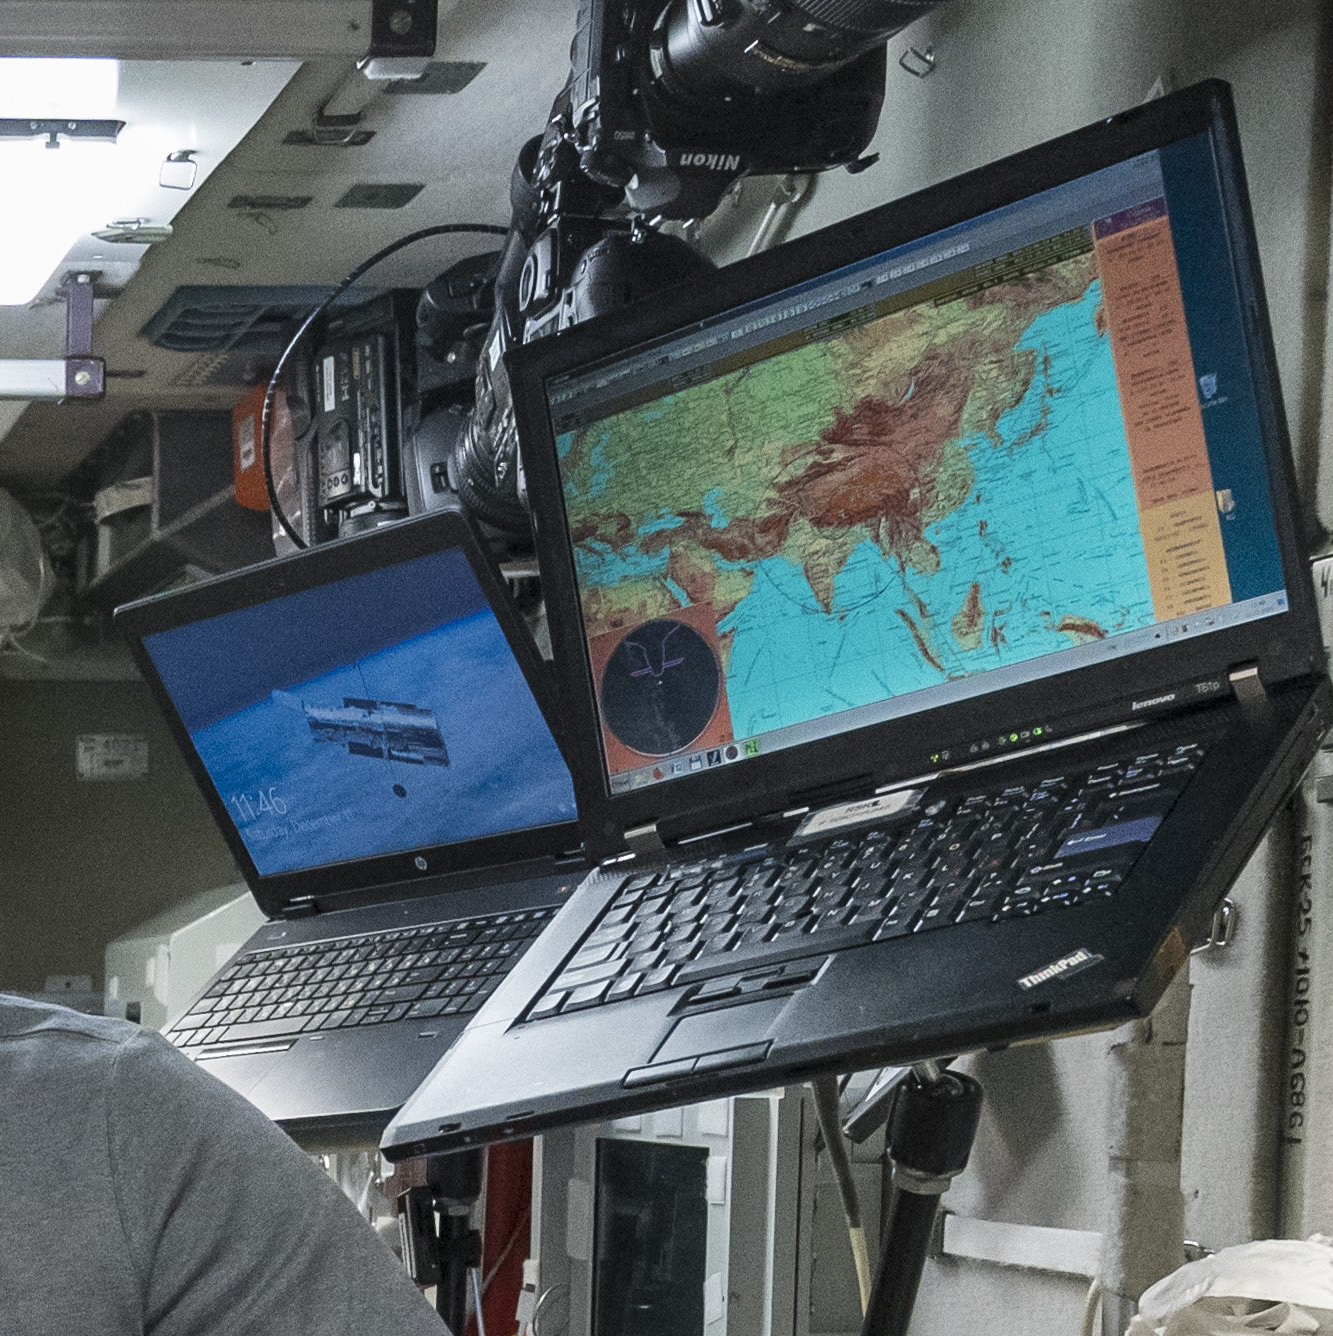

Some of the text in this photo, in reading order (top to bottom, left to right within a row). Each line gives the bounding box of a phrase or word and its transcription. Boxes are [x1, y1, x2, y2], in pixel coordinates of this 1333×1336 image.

[680, 152, 741, 170] Nikon
[1131, 693, 1176, 710] lenovo
[231, 786, 288, 822] 11:46
[1019, 949, 1089, 990] ThinkPad
